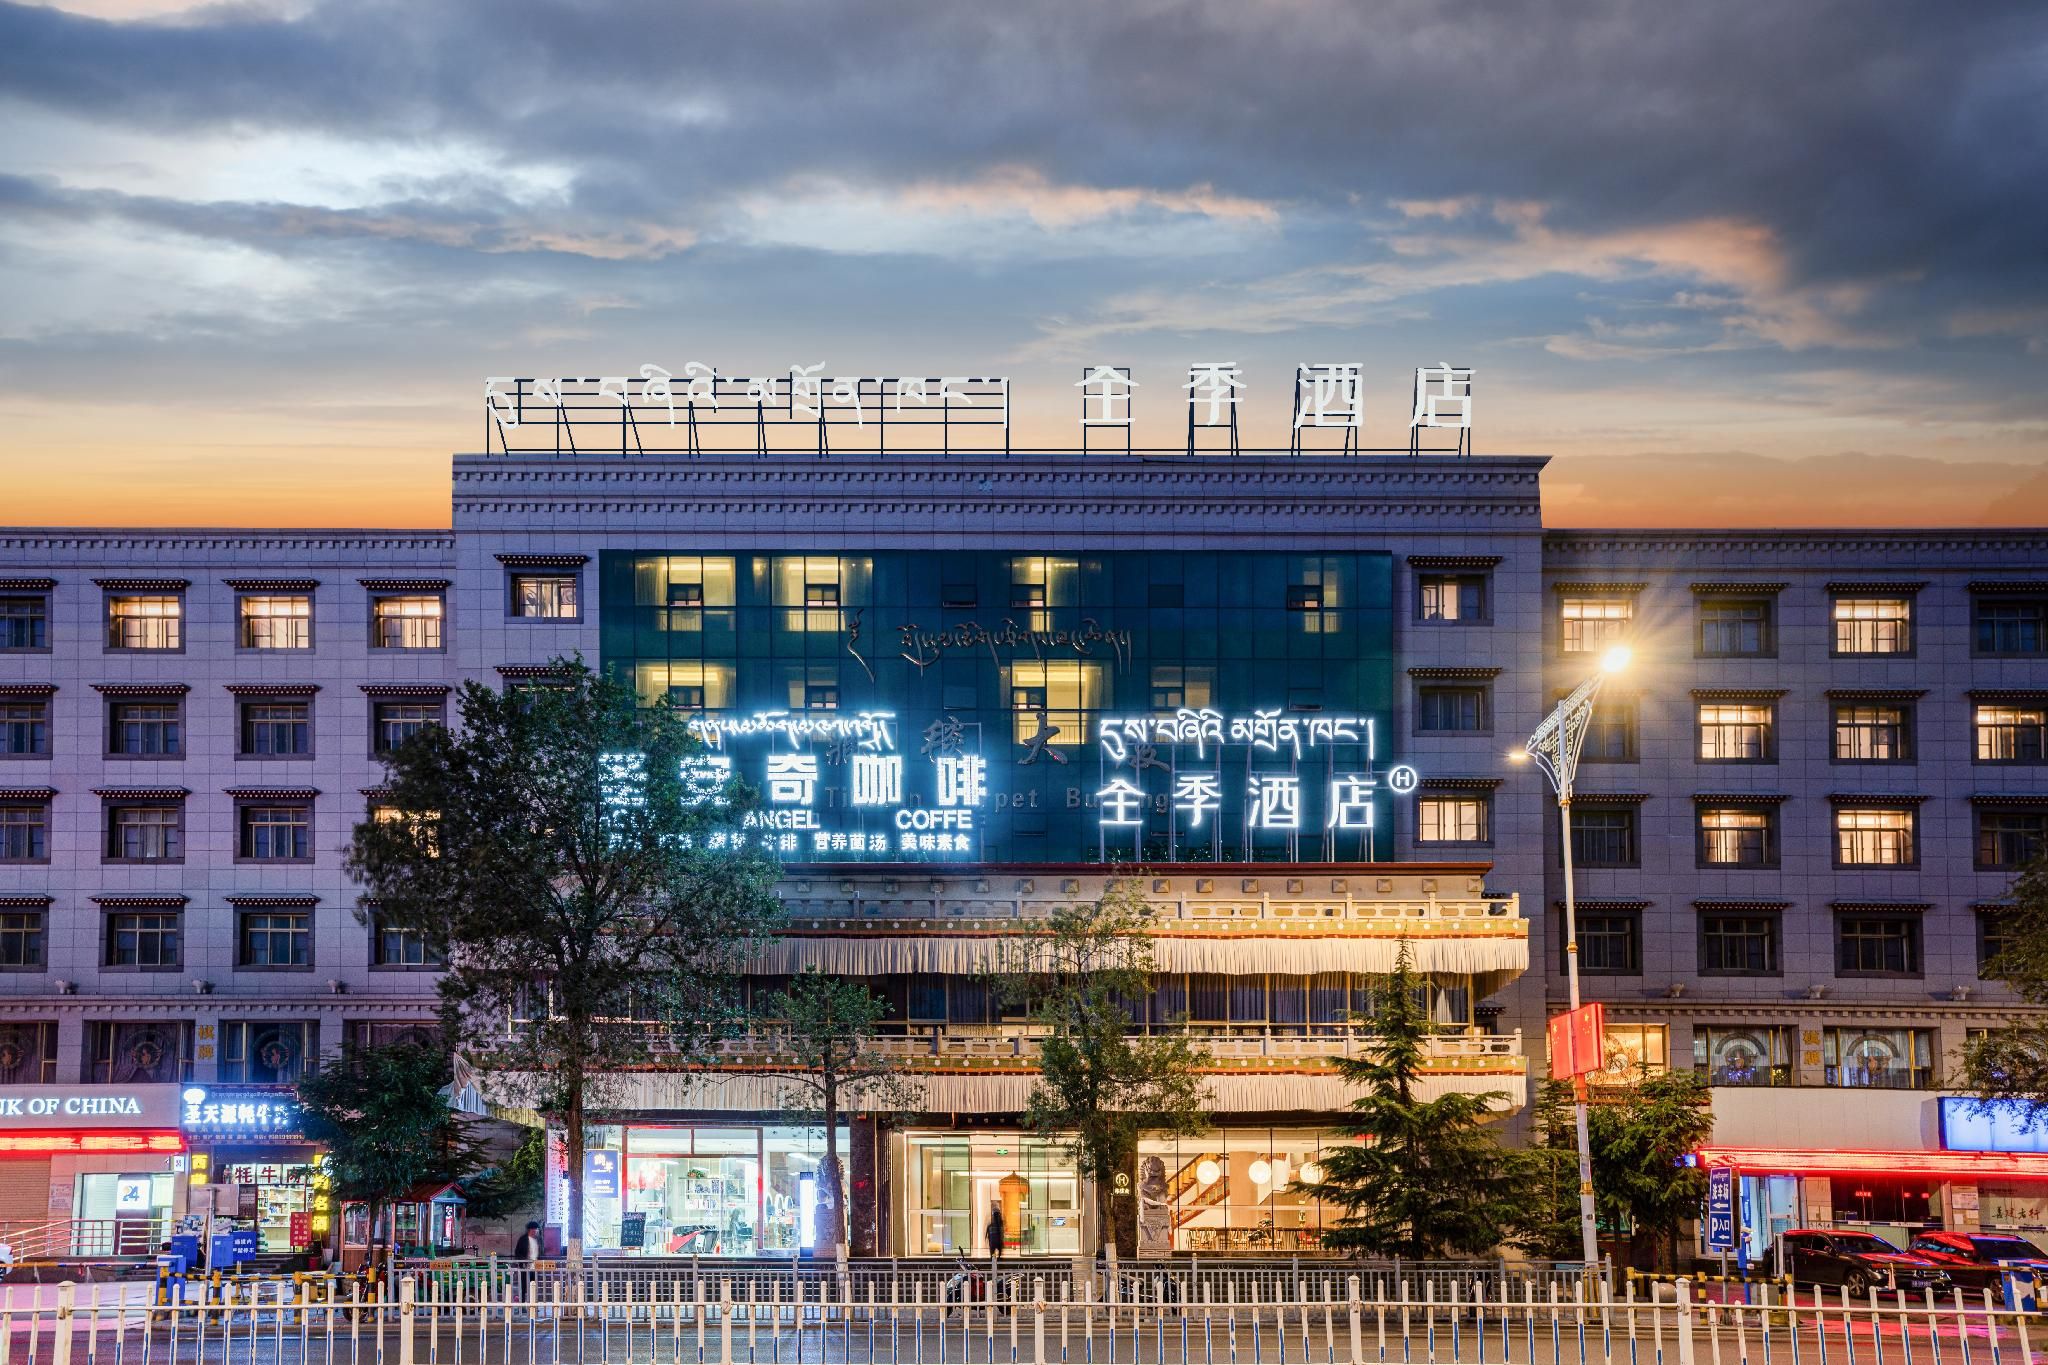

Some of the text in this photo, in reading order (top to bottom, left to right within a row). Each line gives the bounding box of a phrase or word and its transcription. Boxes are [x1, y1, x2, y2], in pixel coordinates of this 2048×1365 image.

[1074, 361, 1476, 429] 全季酒店
[1096, 776, 1377, 829] 全季酒店
[742, 810, 820, 830] ANGEL
[896, 809, 973, 830] COFFE
[0, 1097, 141, 1115] K OF CHINA
